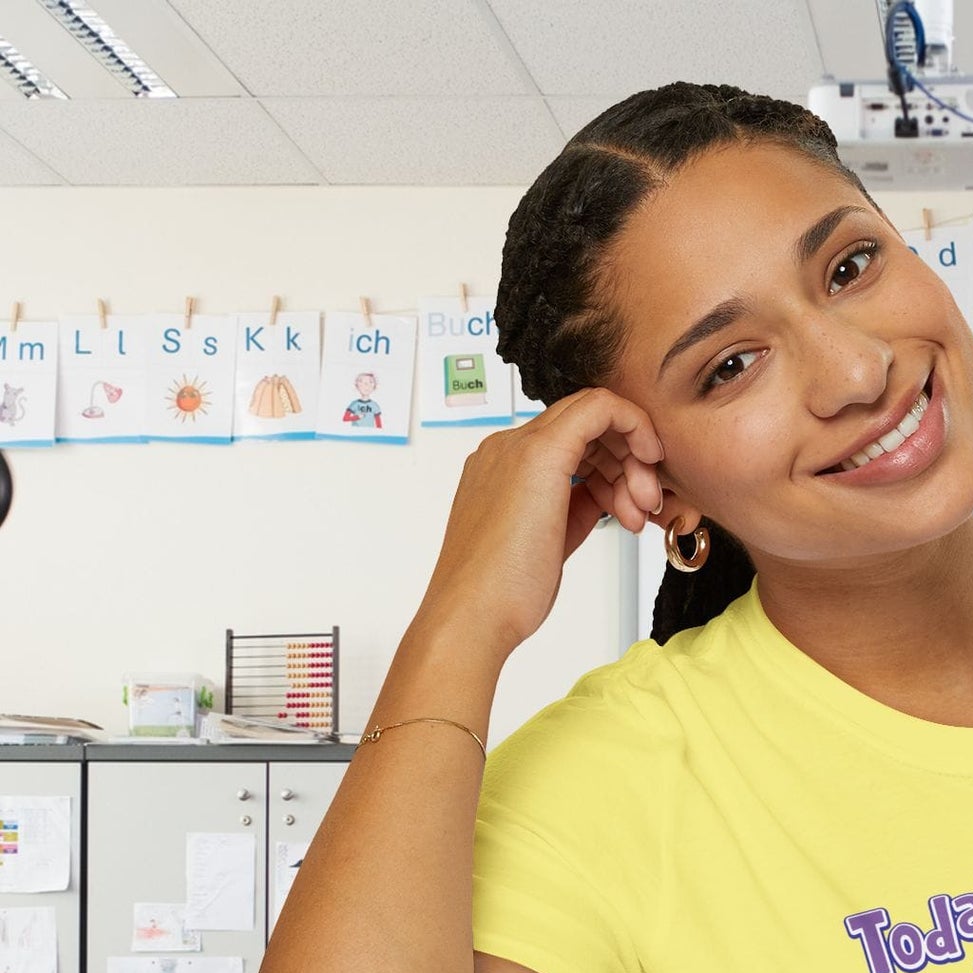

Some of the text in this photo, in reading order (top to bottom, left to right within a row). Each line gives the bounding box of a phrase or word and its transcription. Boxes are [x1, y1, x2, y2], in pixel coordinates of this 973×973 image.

[938, 240, 957, 267] d
[19, 341, 45, 361] m
[75, 330, 92, 356] L
[161, 327, 219, 357] S s
[245, 325, 301, 352] K k
[348, 327, 391, 355] ich
[452, 379, 484, 391] Buch
